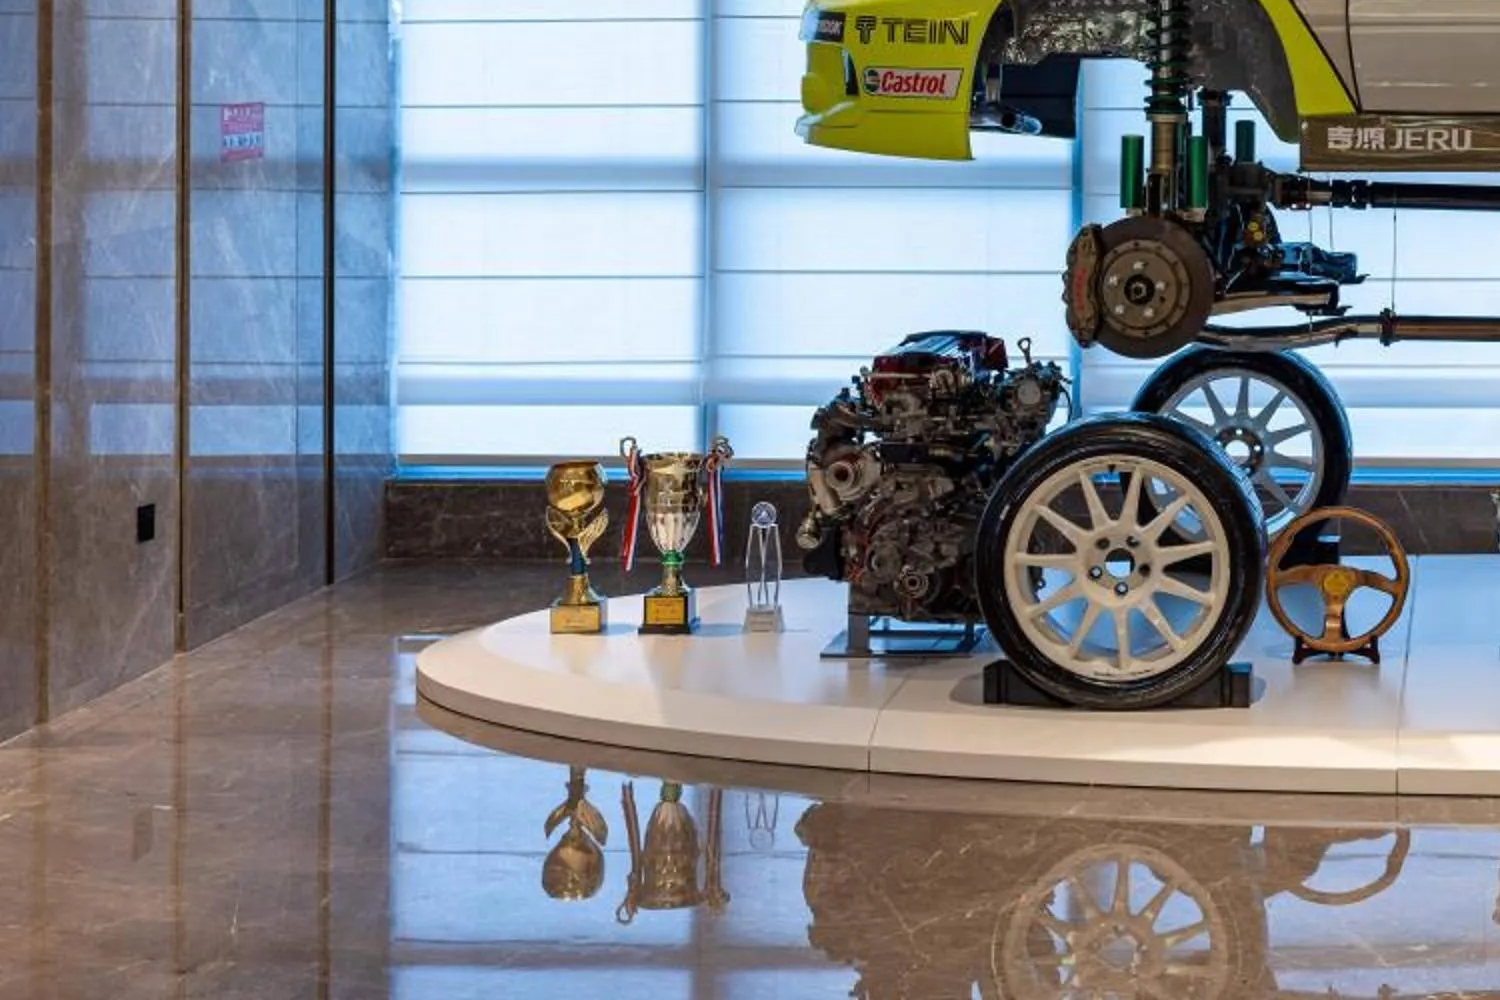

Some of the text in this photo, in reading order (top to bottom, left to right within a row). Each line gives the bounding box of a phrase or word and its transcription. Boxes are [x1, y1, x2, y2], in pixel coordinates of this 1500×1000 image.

[881, 17, 969, 45] TEIN
[881, 71, 947, 94] Castrol
[1390, 126, 1473, 152] JERU
